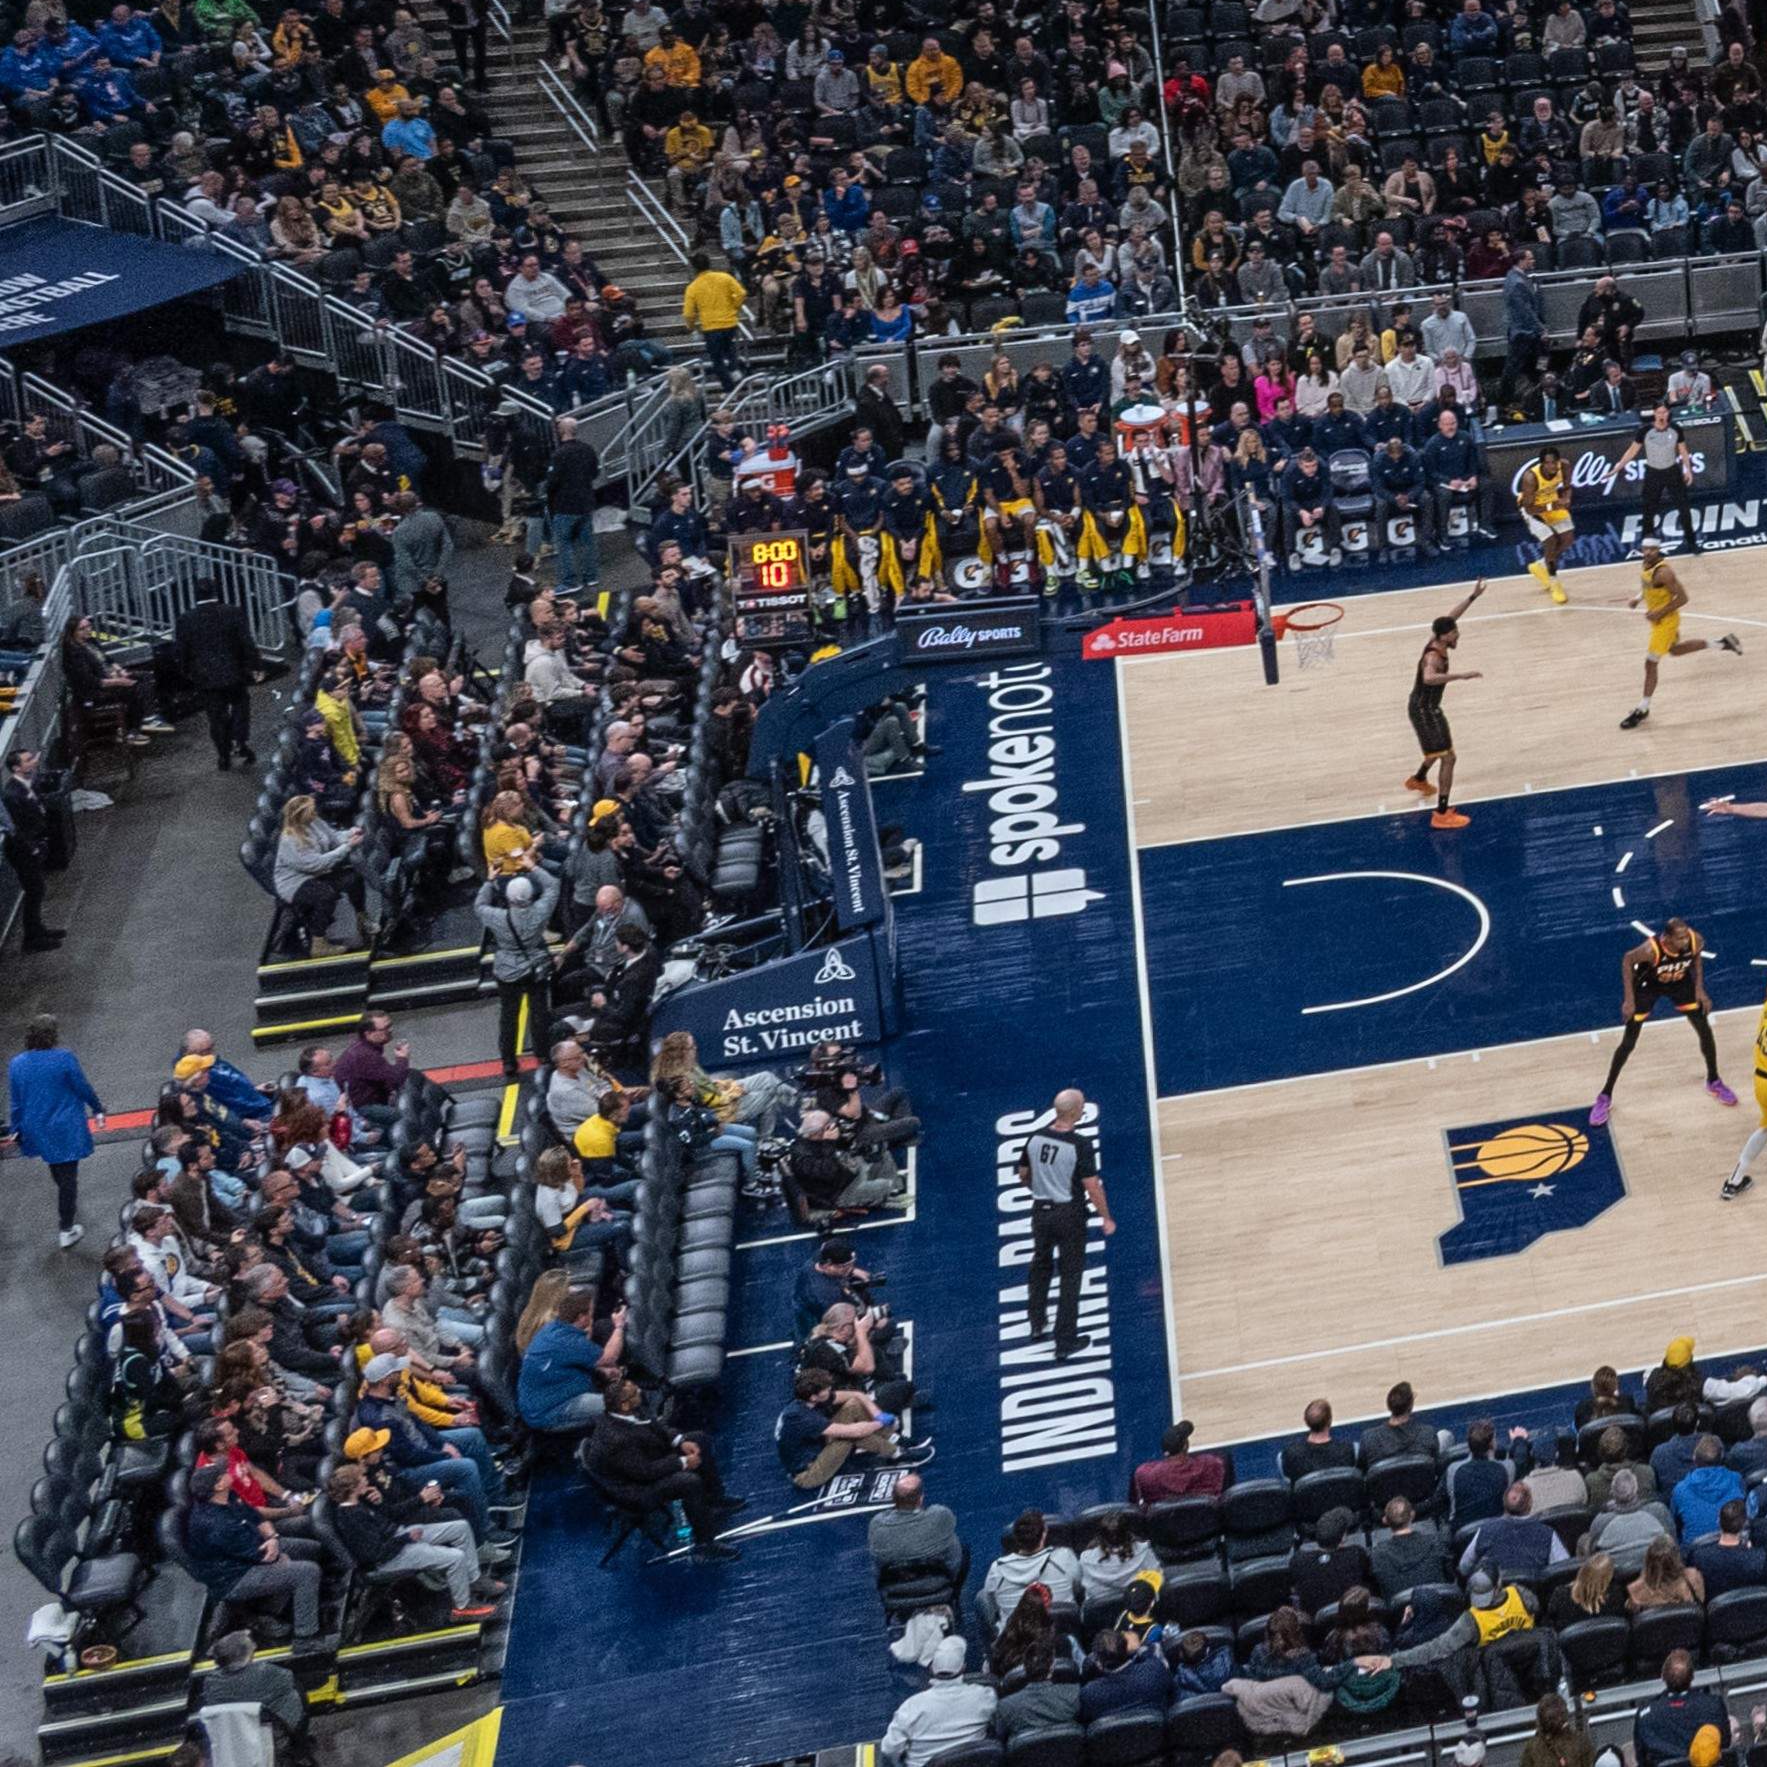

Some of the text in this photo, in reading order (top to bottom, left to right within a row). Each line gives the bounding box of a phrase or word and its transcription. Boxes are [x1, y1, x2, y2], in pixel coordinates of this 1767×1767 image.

[753, 540, 797, 564] 8:00
[761, 564, 789, 587] 10
[918, 626, 1021, 648] Bally SPORTS
[1117, 626, 1203, 646] StateFarm
[724, 996, 854, 1031] Ascension
[724, 1019, 863, 1057] St. Vincent
[1040, 1145, 1058, 1165] 67
